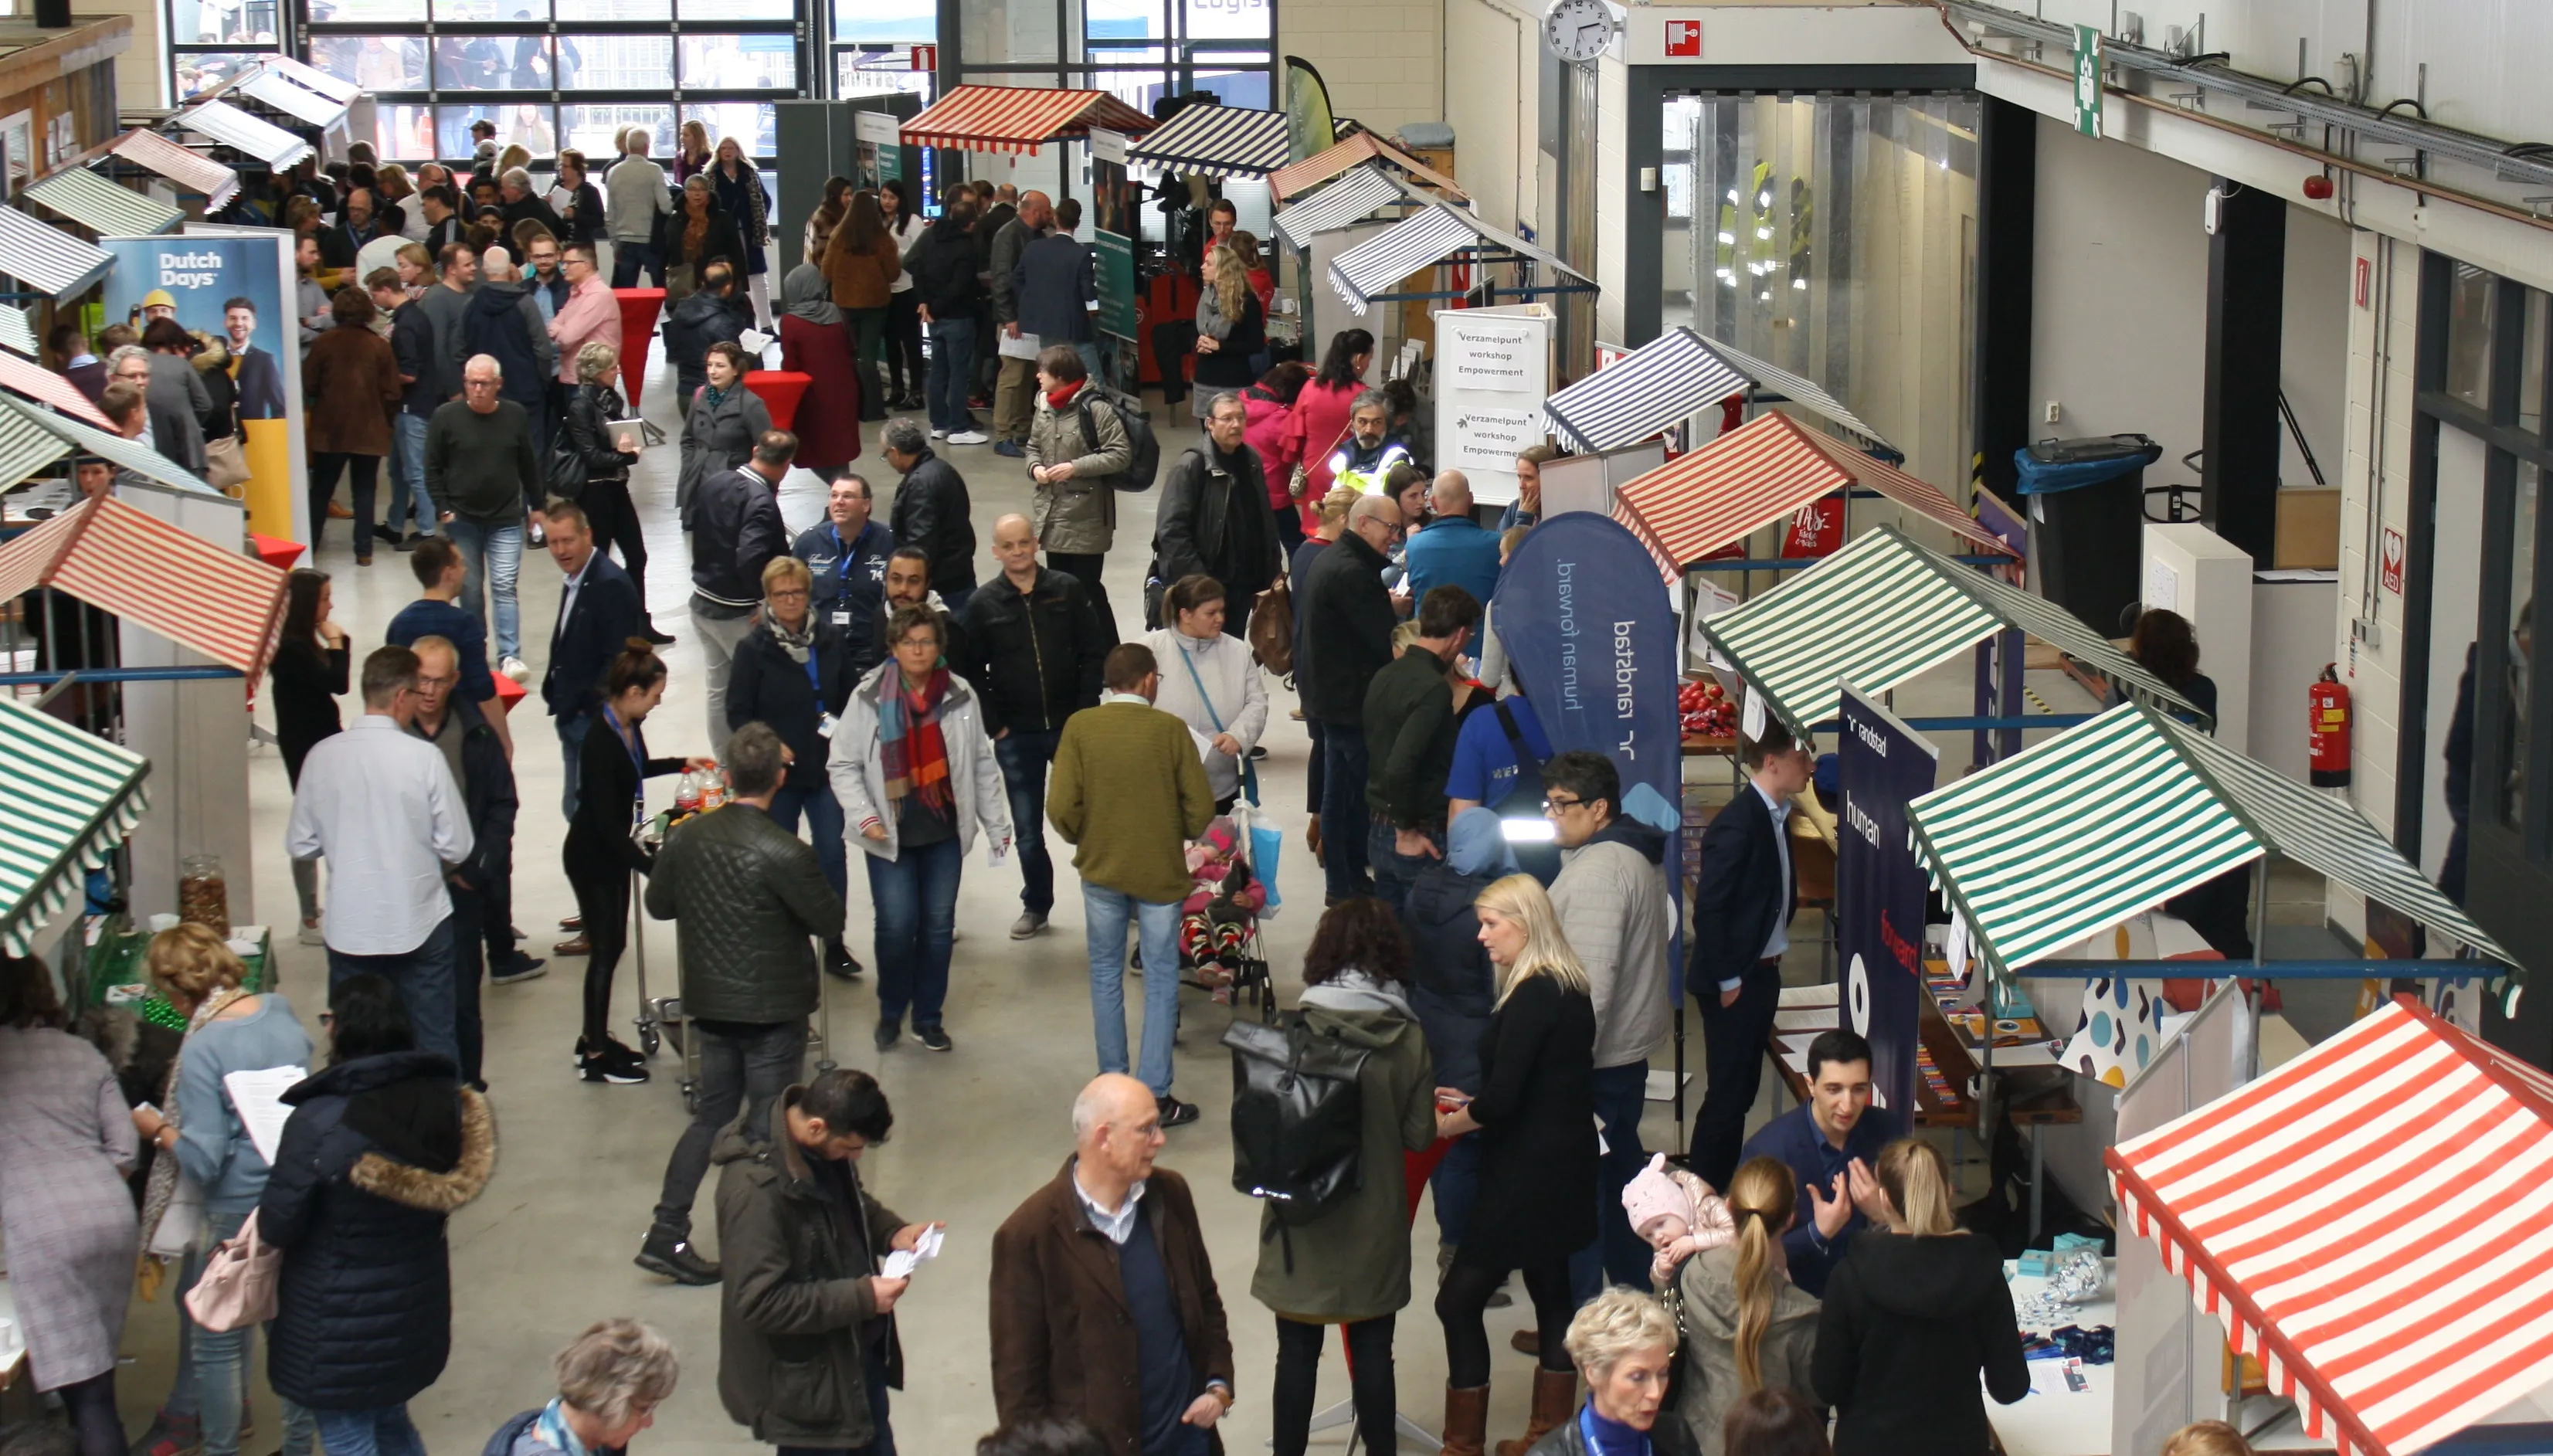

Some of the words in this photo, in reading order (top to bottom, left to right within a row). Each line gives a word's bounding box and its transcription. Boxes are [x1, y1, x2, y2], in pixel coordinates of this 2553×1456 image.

[160, 252, 222, 269] Dutch
[161, 270, 216, 290] Days
[1459, 333, 1522, 345] Verzamelpunt
[1469, 350, 1512, 361] workshop
[1458, 365, 1523, 376] Empowerment
[1465, 413, 1526, 426] Verzamelpunt
[1474, 431, 1516, 443] workshop
[1463, 446, 1521, 457] Empowerme
[870, 569, 884, 581] 74
[2384, 569, 2399, 592] AED
[1859, 723, 1886, 758] randstad
[1847, 789, 1879, 850] human
